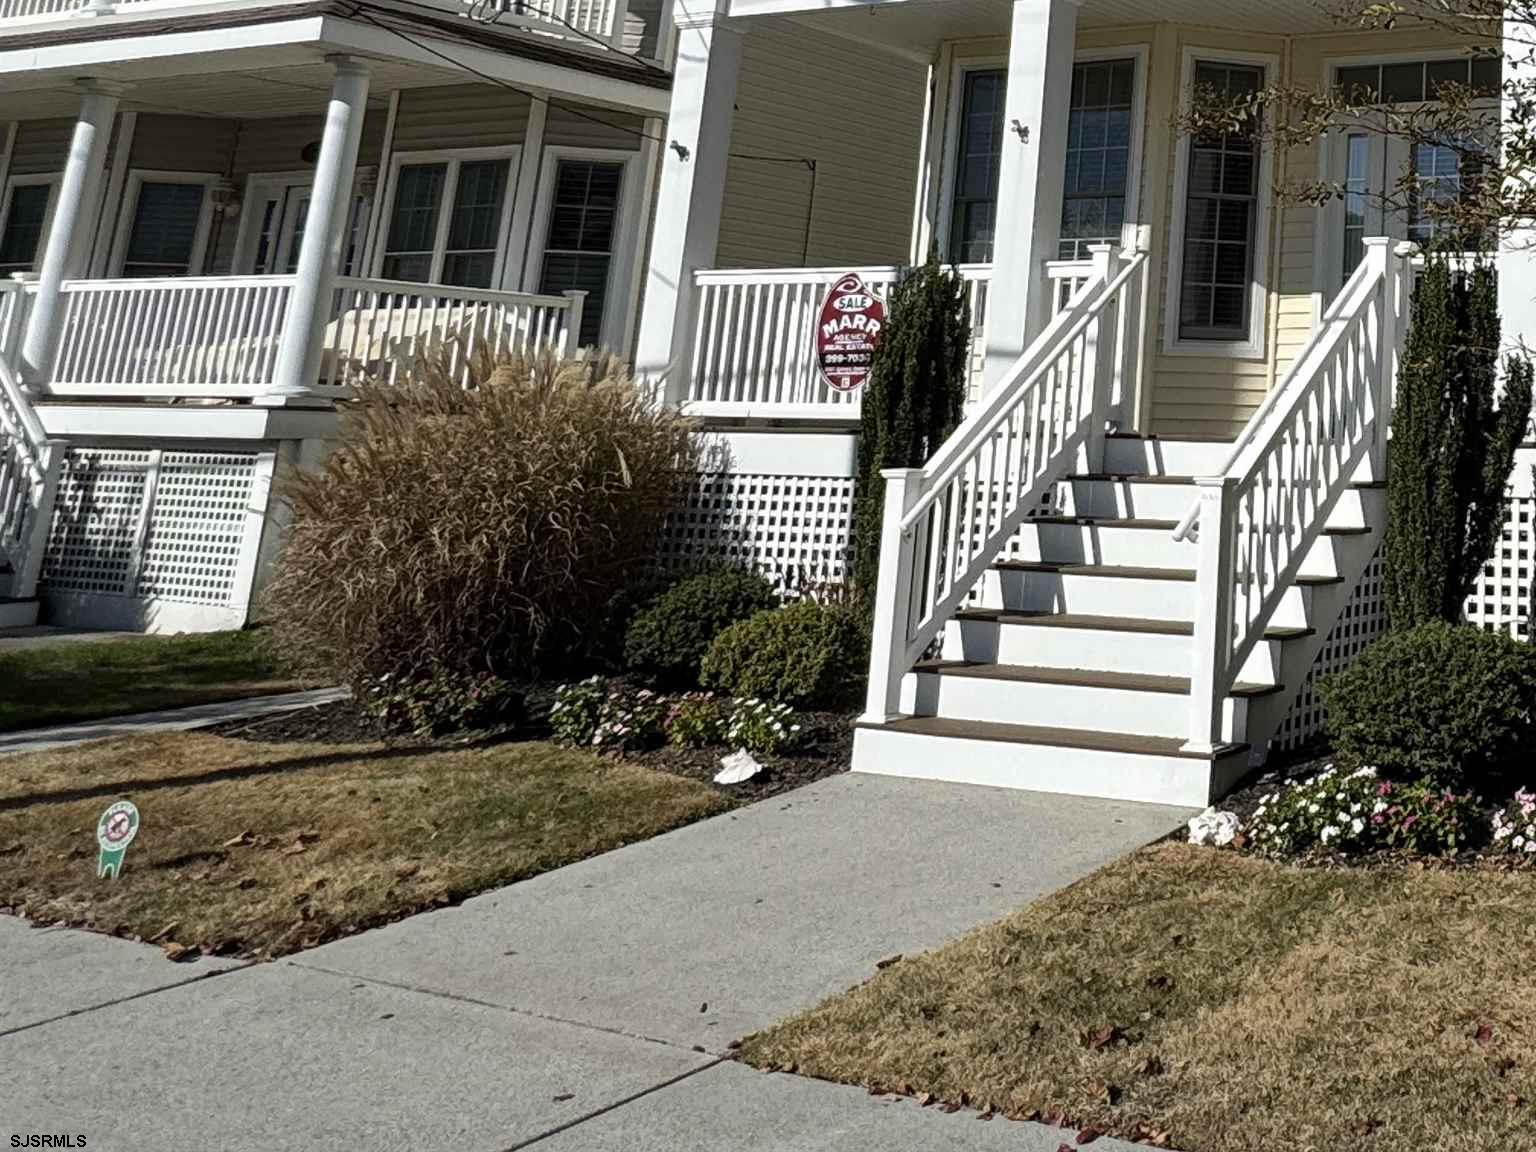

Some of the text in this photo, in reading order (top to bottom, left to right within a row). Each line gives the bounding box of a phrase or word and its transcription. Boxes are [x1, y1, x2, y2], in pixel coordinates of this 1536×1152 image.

[839, 297, 867, 309] SALE
[823, 314, 880, 339] MARR
[833, 333, 867, 341] AGENCY
